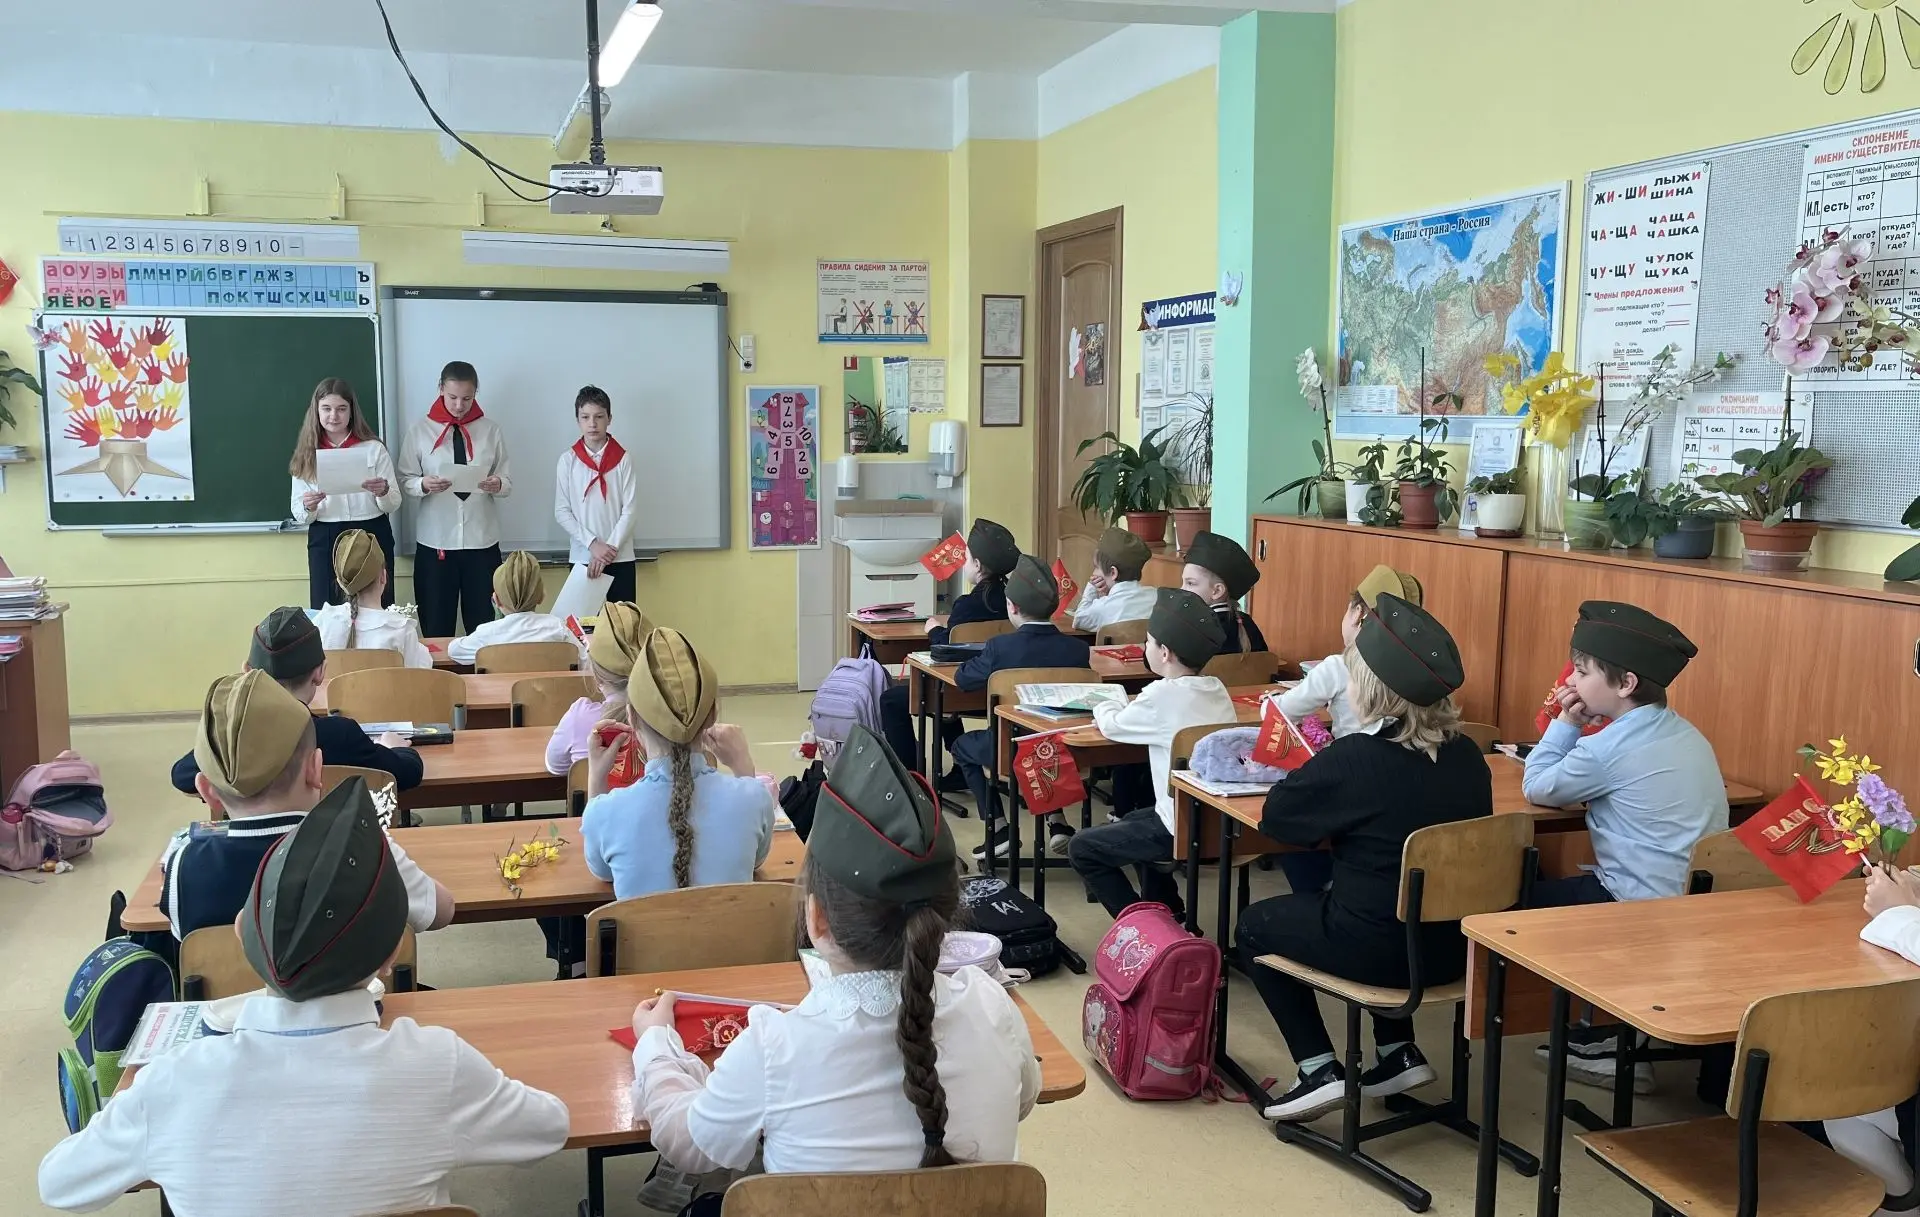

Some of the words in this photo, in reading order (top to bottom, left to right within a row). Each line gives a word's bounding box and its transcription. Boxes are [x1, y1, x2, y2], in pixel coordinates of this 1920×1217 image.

[1852, 129, 1909, 147] СКЛОНЕНИЕ
[1814, 152, 1844, 165] ИМЕНИ
[1654, 171, 1701, 186] ЛЫЖИ
[1890, 170, 1911, 179] вопрос
[1650, 186, 1694, 200] ШИНА
[1857, 192, 1876, 201] кто?
[1806, 200, 1821, 217] И.П.
[1823, 201, 1849, 212] есть
[1856, 203, 1875, 212] что?
[1649, 211, 1696, 225] ЧАЩА
[1393, 229, 1417, 241] Наша
[1420, 223, 1450, 239] страна
[1458, 217, 1490, 231] Россия
[1881, 221, 1916, 231] откуда?
[1647, 225, 1700, 239] ЧАШКА
[1852, 231, 1876, 240] кого?
[1885, 232, 1910, 241] куда?
[1887, 241, 1907, 250] где?
[1645, 251, 1694, 264] ЧУЛОК
[820, 263, 851, 271] ПРАВИЛА
[854, 263, 886, 272] СИДЕНИЯ
[900, 263, 927, 272] ПАРТОЙ
[1645, 266, 1690, 279] ЩУКА
[1876, 269, 1903, 277] КУДА?
[1878, 278, 1900, 286] ГДЕ?
[1594, 290, 1619, 300] Члены
[1620, 285, 1685, 299] предложения
[1650, 301, 1665, 309] кто?
[1874, 298, 1902, 306] КУДА?
[1615, 320, 1642, 328] сказуемое
[1642, 326, 1666, 334] делает?
[1720, 395, 1759, 404] ОКОНЧАНИЯ
[1697, 406, 1715, 415] ИМЕН
[1716, 405, 1784, 415] СУЩЕСТВИТЕЛЬНЫХ
[785, 436, 792, 447] 5
[1684, 443, 1699, 453] Р.П.
